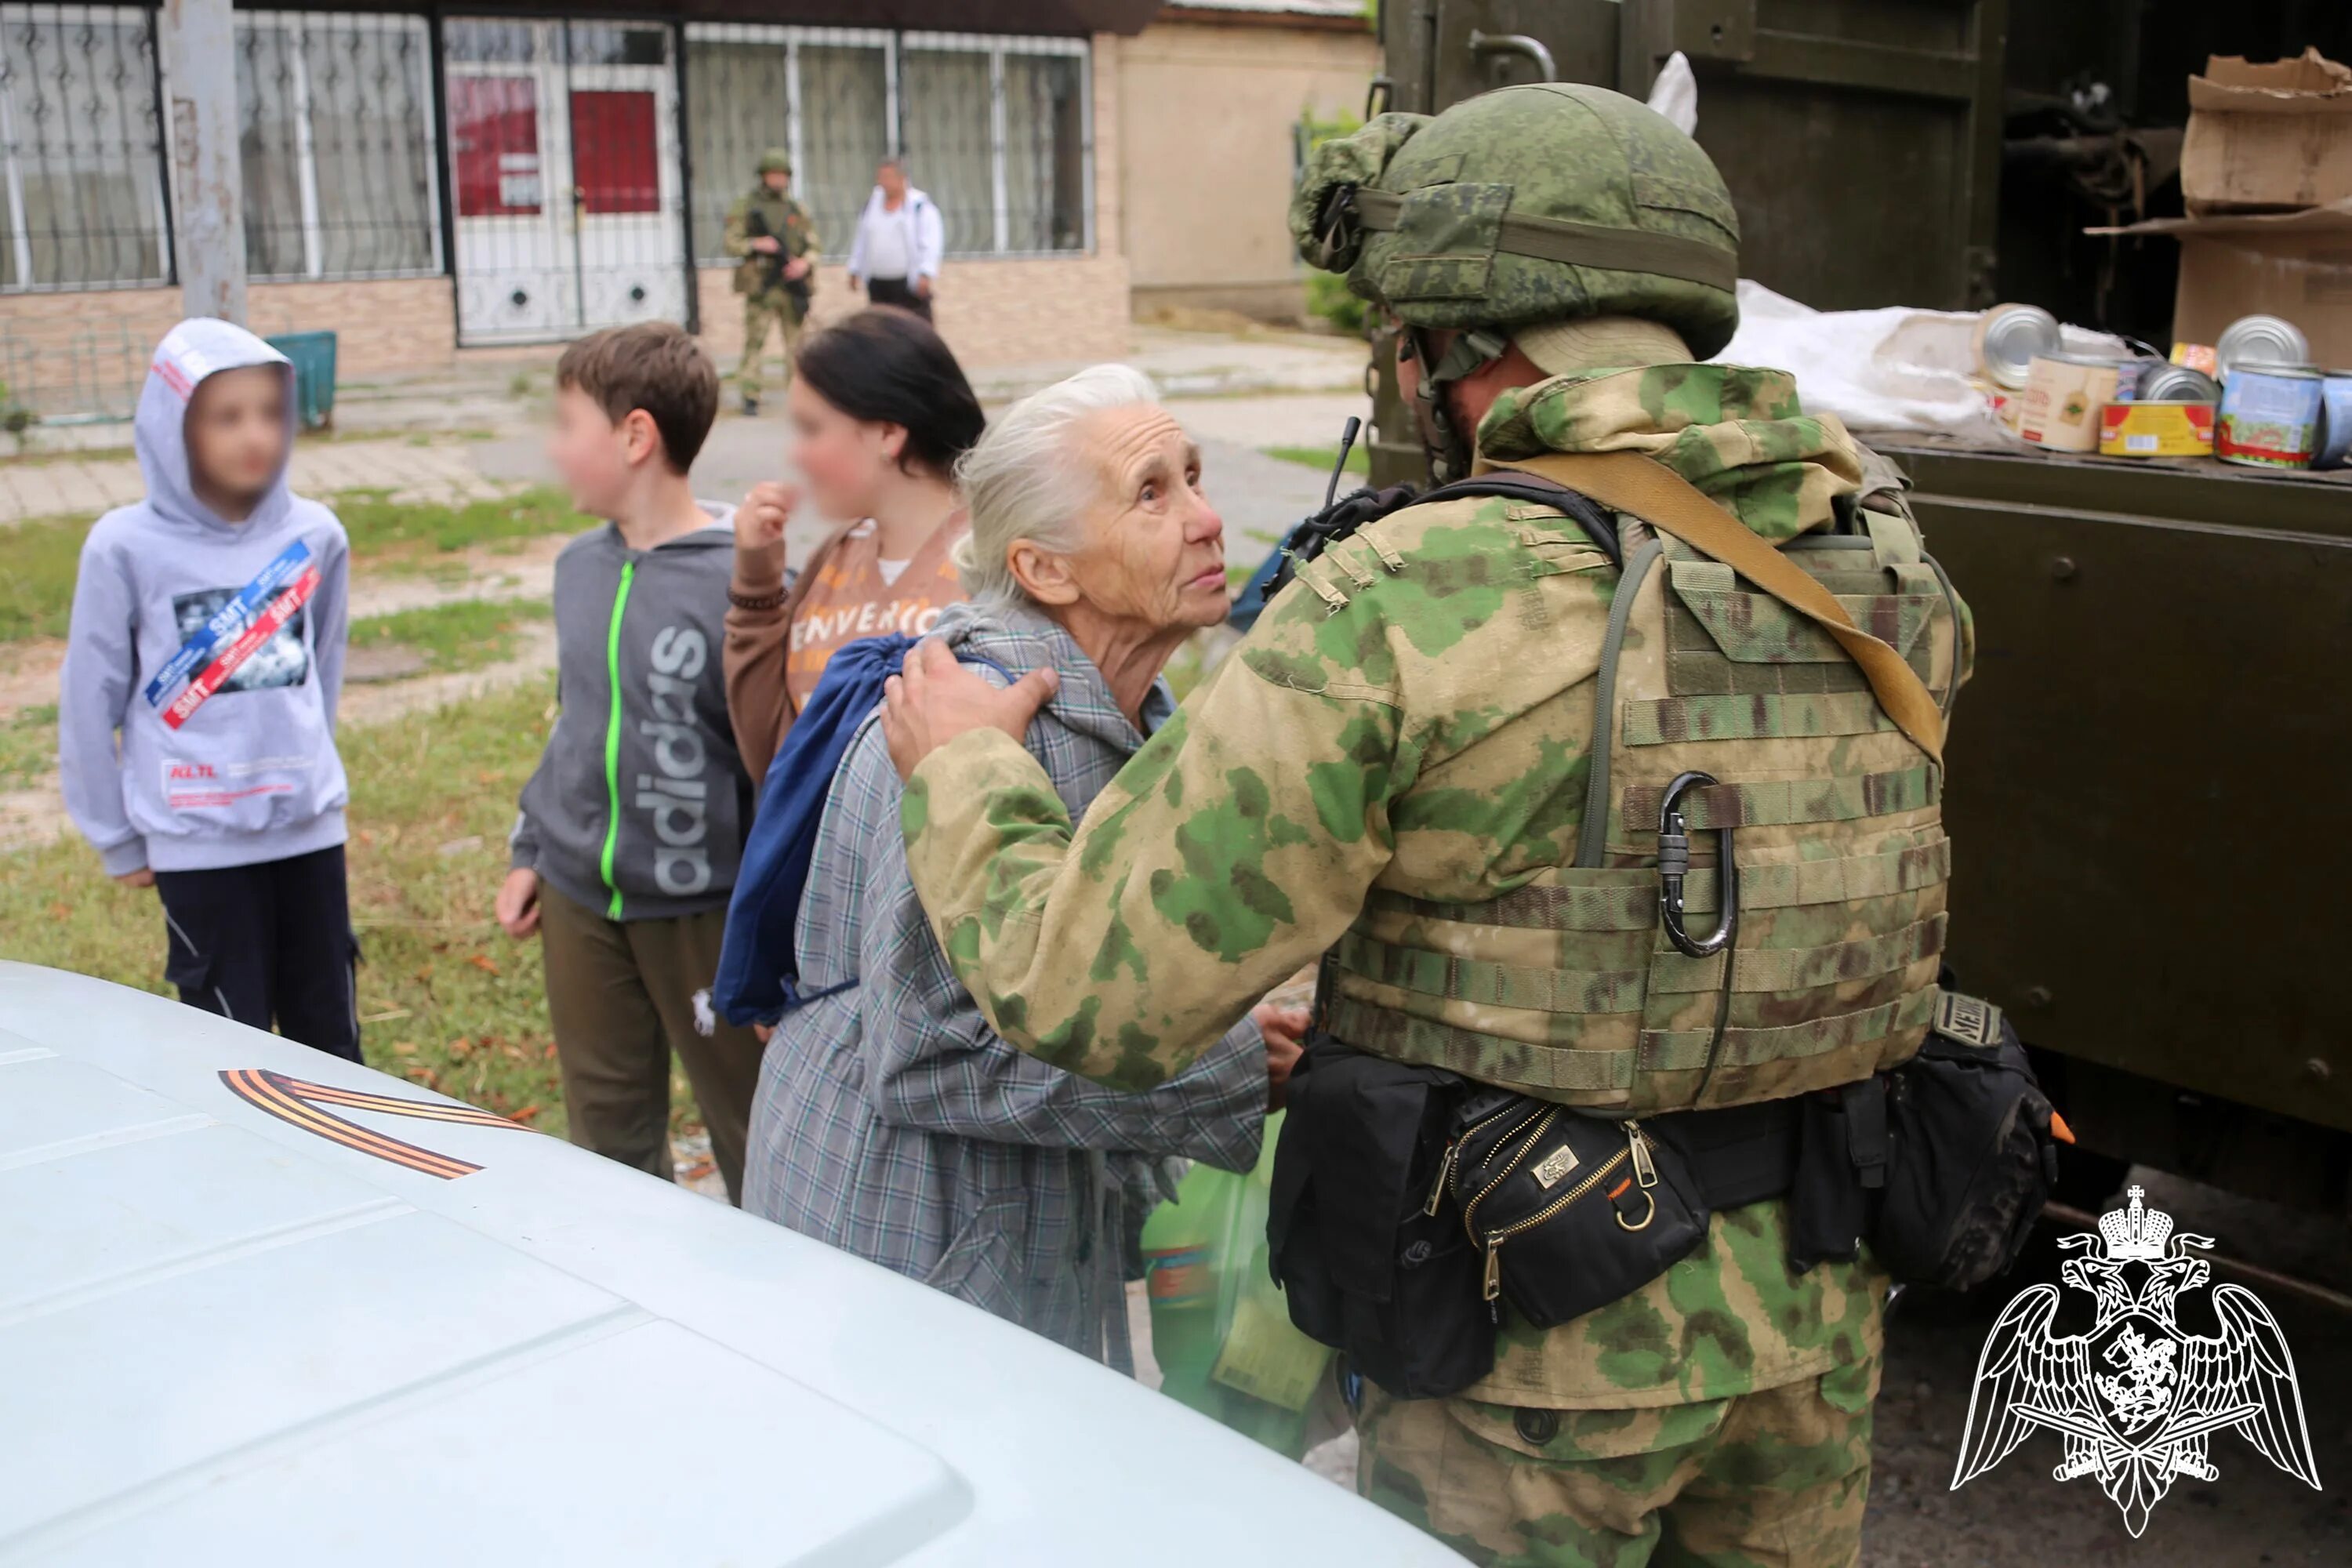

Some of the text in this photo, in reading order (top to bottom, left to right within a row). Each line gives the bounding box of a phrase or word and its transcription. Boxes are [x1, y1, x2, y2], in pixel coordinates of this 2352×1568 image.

[209, 595, 250, 637] SMT
[270, 588, 303, 625] SMT
[172, 677, 210, 720] SMT
[636, 625, 711, 896] adidas
